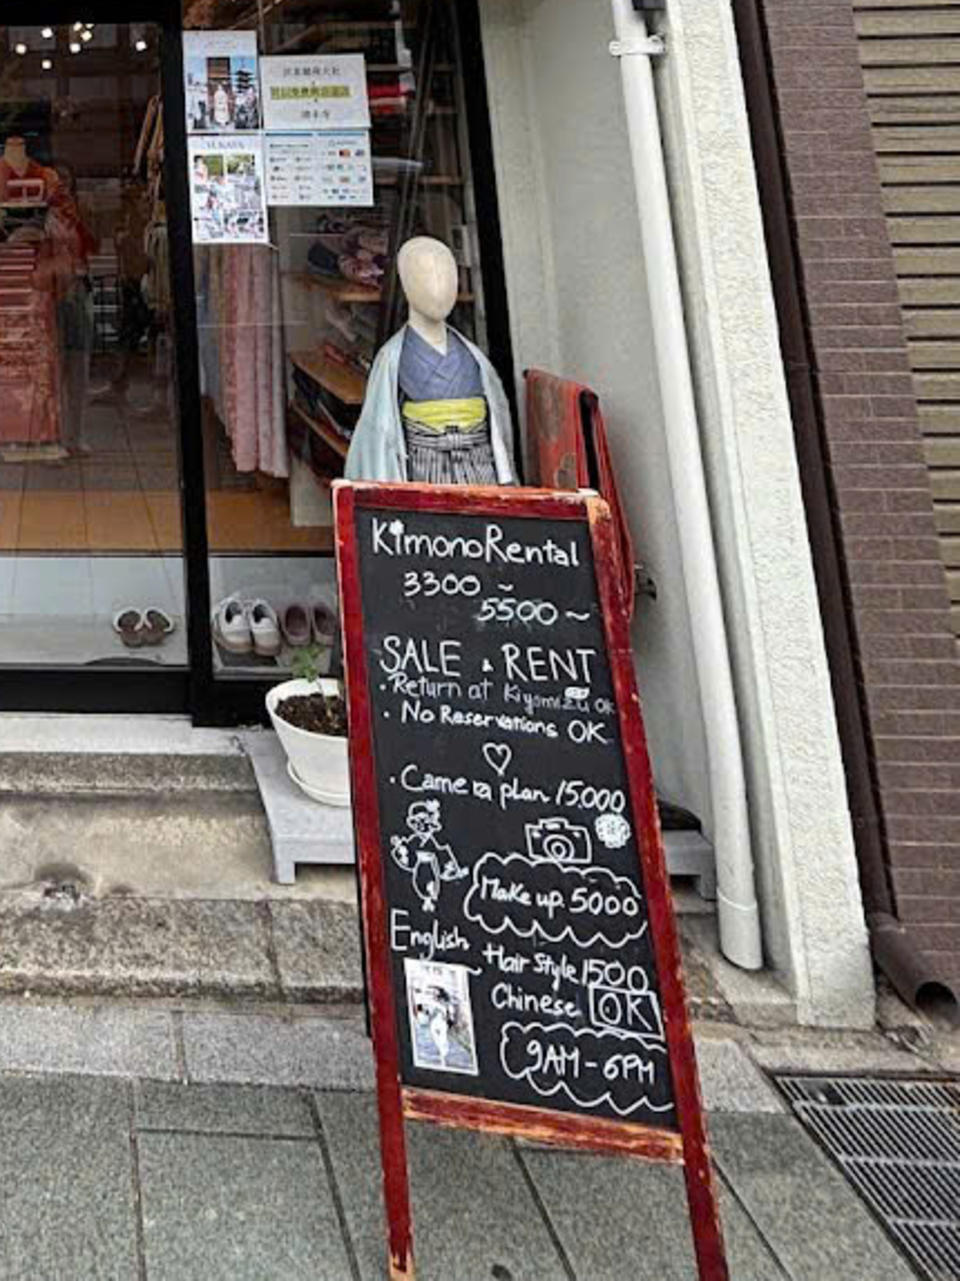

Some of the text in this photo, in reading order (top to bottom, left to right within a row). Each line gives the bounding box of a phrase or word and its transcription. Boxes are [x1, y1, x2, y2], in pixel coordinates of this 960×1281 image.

[379, 634, 462, 678] SALE
[500, 642, 596, 684] RENT
[387, 671, 462, 698] Return
[468, 677, 494, 700] at
[401, 700, 436, 724] No
[567, 719, 609, 745] OK
[499, 777, 551, 811] plan
[480, 874, 533, 907] Make
[569, 886, 640, 917] 5000
[390, 907, 471, 961] English
[482, 942, 531, 974] Hair
[582, 958, 650, 995] 1500
[491, 982, 654, 1032] Chinese OK
